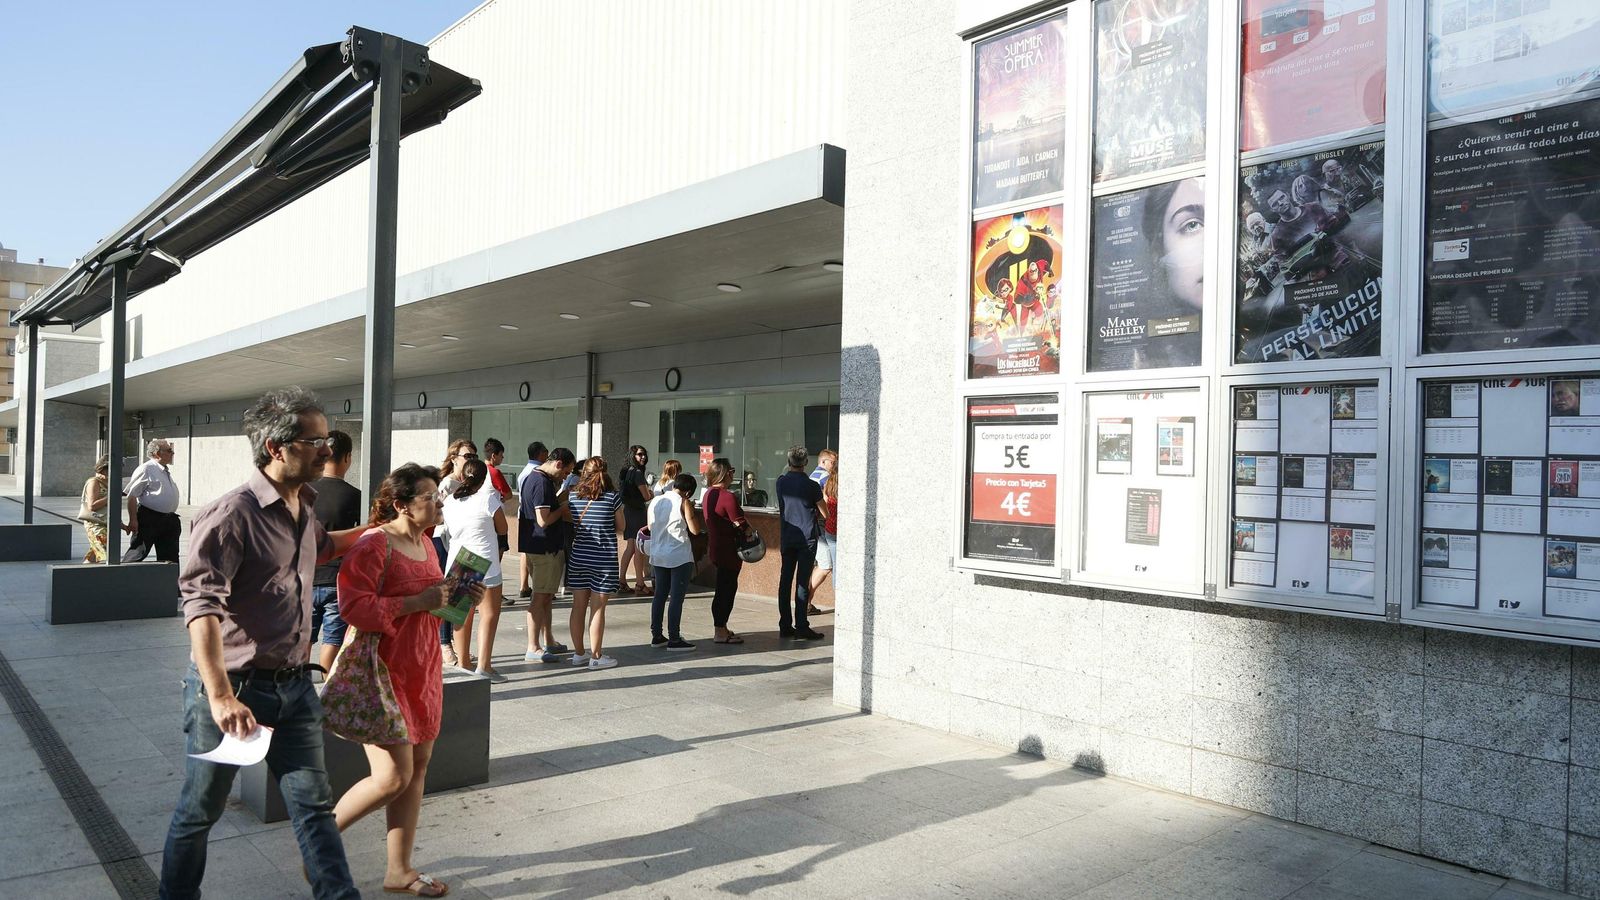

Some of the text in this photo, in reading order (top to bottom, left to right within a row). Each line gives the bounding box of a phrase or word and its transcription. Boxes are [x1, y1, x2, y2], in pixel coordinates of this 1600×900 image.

[1004, 33, 1043, 59] SUMMER
[1004, 50, 1044, 74] OPERA
[1498, 112, 1537, 125] CINE SUR
[1458, 120, 1580, 149] ¿Quieres venir al cine a
[1130, 137, 1174, 158] MUSE
[1434, 130, 1600, 164] 5 euros la entrada todos los días
[984, 149, 1059, 174] TURANDOT AIDA CARMEN
[1314, 150, 1346, 161] KINGSLEY
[1280, 159, 1299, 169] JONES
[1020, 168, 1050, 184] BUTTERFLY
[1480, 268, 1501, 276] PRIMER
[1294, 283, 1339, 295] PRÓXIMO ESTRENO
[1324, 289, 1340, 297] JULIO
[1107, 316, 1140, 329] MARY
[1319, 300, 1381, 349] LÍMITE
[1099, 324, 1146, 338] SHELLEY
[1291, 343, 1315, 361] AL
[997, 357, 1006, 369] LOS
[1035, 354, 1040, 367] 2
[1483, 377, 1546, 388] CINE SUR
[1281, 387, 1299, 396] CINE
[1313, 386, 1329, 395] SUR
[981, 431, 1052, 442] Compra tu entrada por
[1003, 444, 1030, 469] 5€
[985, 478, 1007, 487] Precio
[1007, 479, 1020, 487] con
[1000, 491, 1032, 517] 4€
